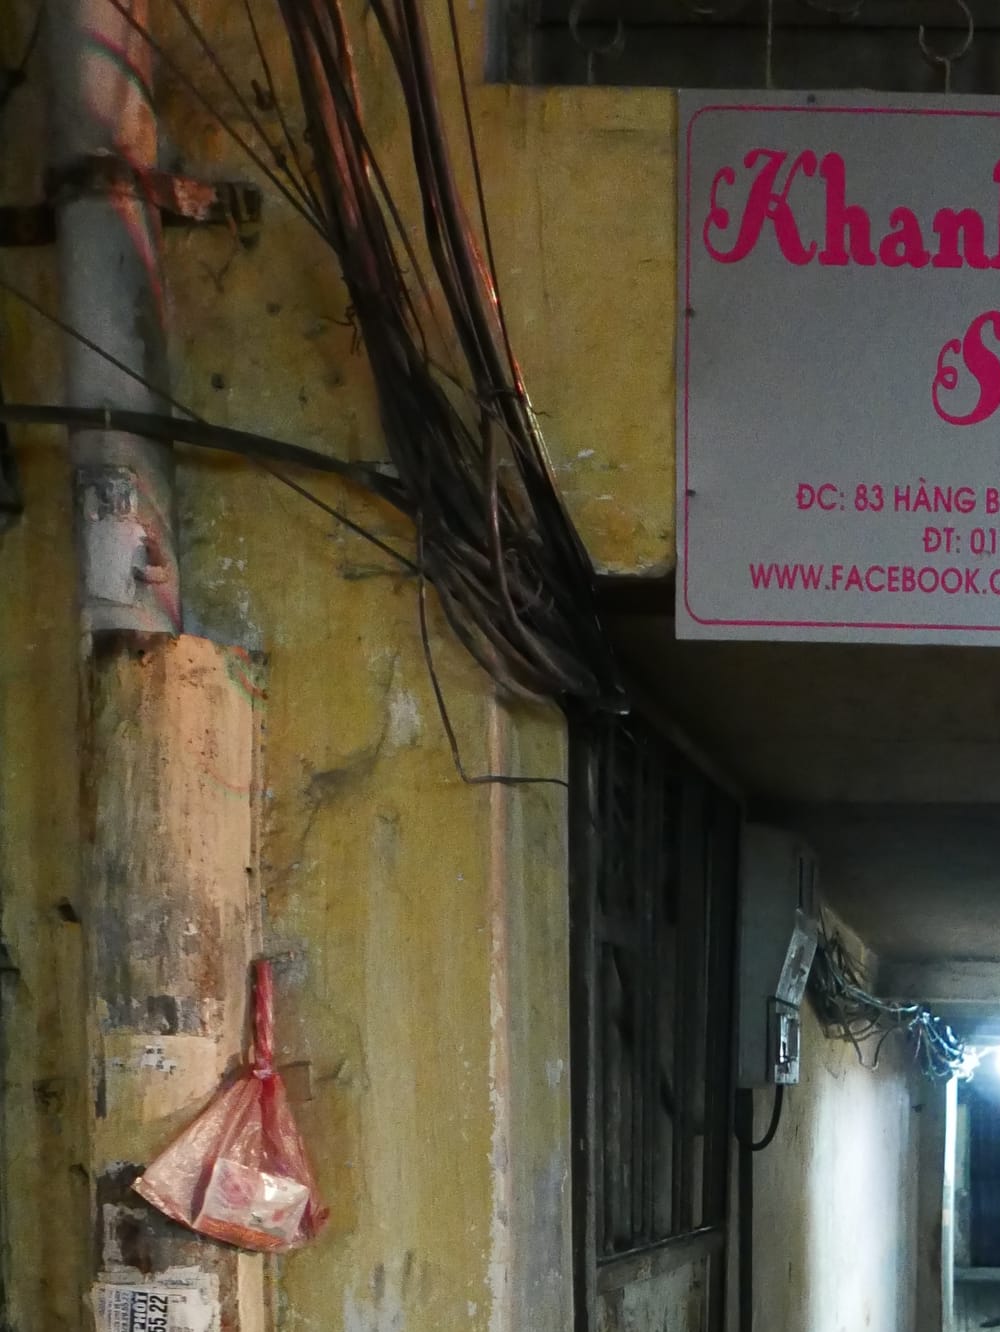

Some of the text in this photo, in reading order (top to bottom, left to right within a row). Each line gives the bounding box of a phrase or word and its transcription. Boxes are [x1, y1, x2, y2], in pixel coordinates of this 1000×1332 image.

[796, 482, 846, 511] ĐC:
[854, 483, 884, 512] 83
[894, 477, 976, 514] HÀNG
[923, 527, 962, 553] ĐT:
